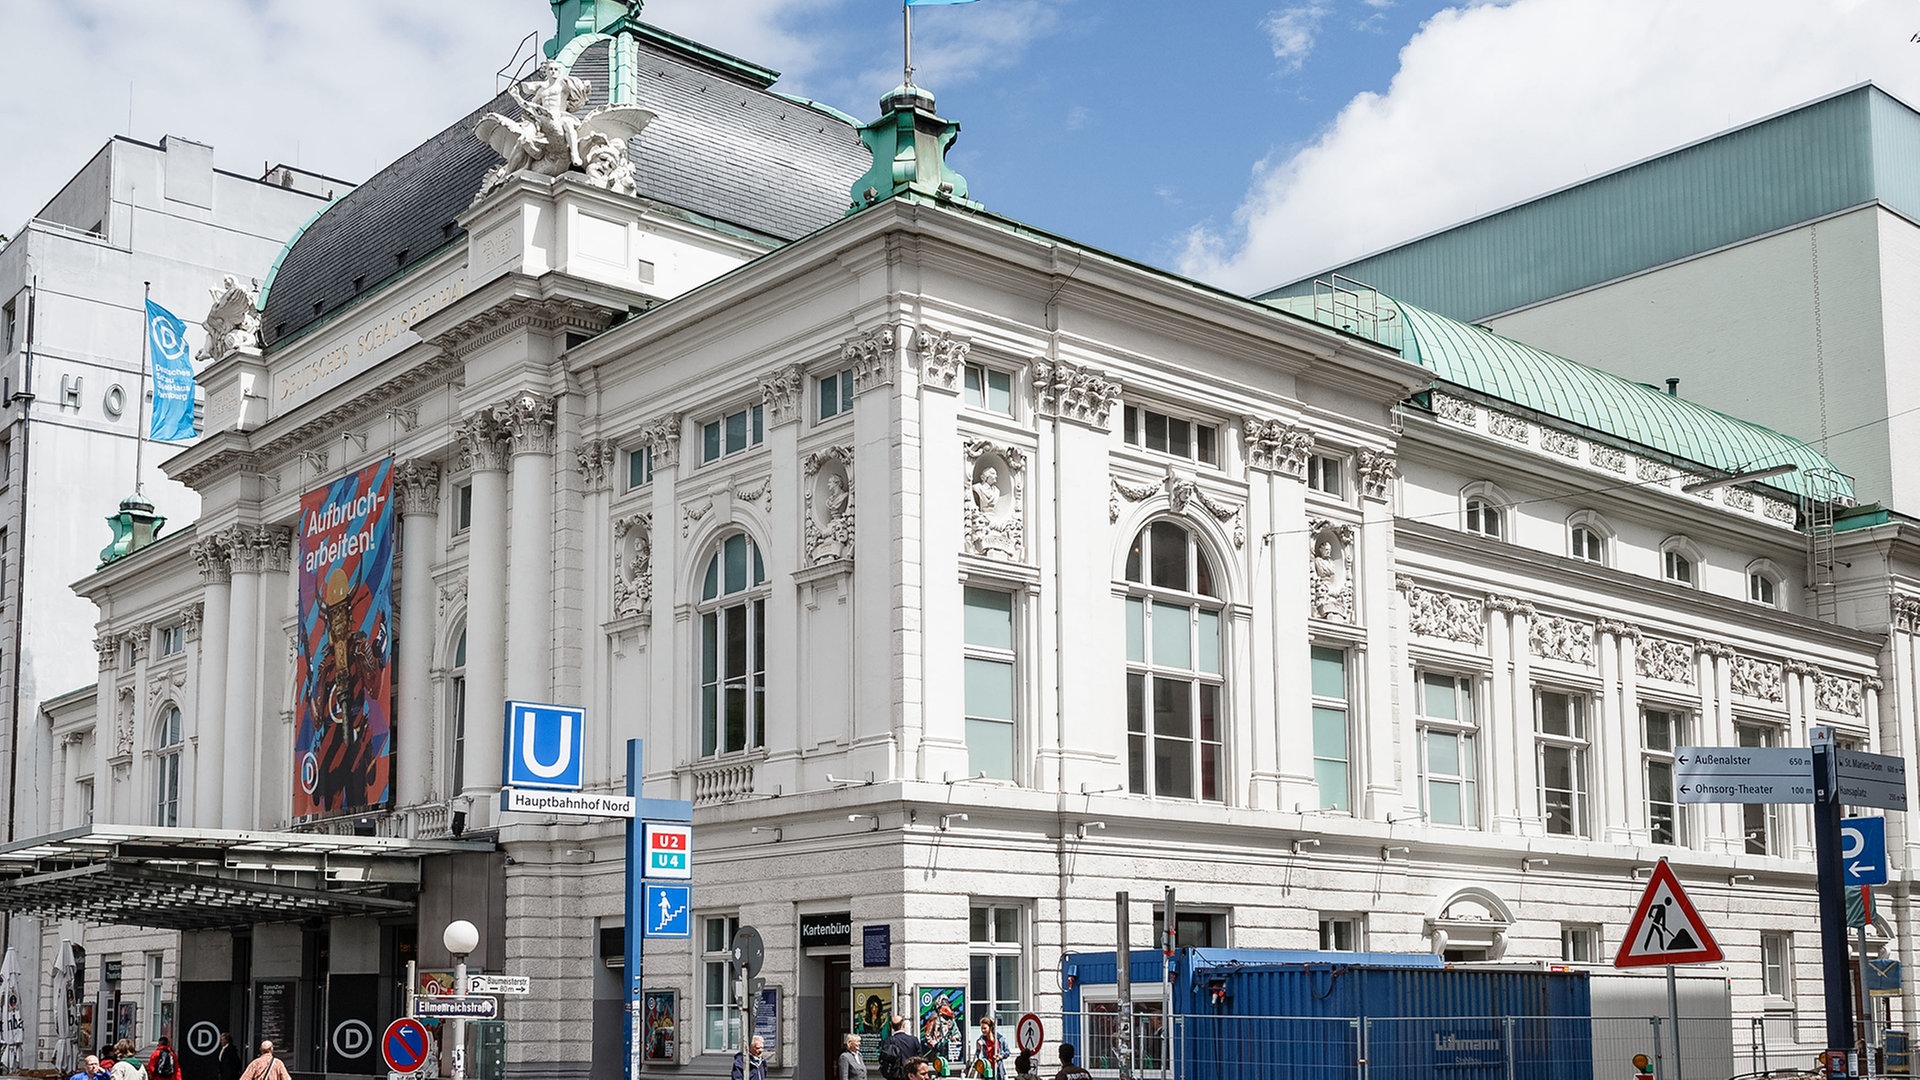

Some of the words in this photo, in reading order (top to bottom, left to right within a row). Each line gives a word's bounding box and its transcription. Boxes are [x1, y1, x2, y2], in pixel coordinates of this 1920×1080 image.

[280, 343, 349, 400] DEUTSCHES
[306, 487, 385, 538] Aufbruch-
[306, 531, 375, 573] arbeiten!
[522, 711, 573, 779] U
[1695, 754, 1751, 766] Außenalster
[1789, 757, 1803, 766] 650
[1695, 783, 1773, 796] Ohnsorg-Theater
[1791, 786, 1803, 795] 100
[515, 795, 600, 814] Hauptbahnhof
[602, 801, 630, 813] Nord
[802, 922, 850, 937] Kartenbüro
[487, 977, 527, 987] Baumeisterstr.
[419, 1001, 492, 1014] Ellmenreichstraß
